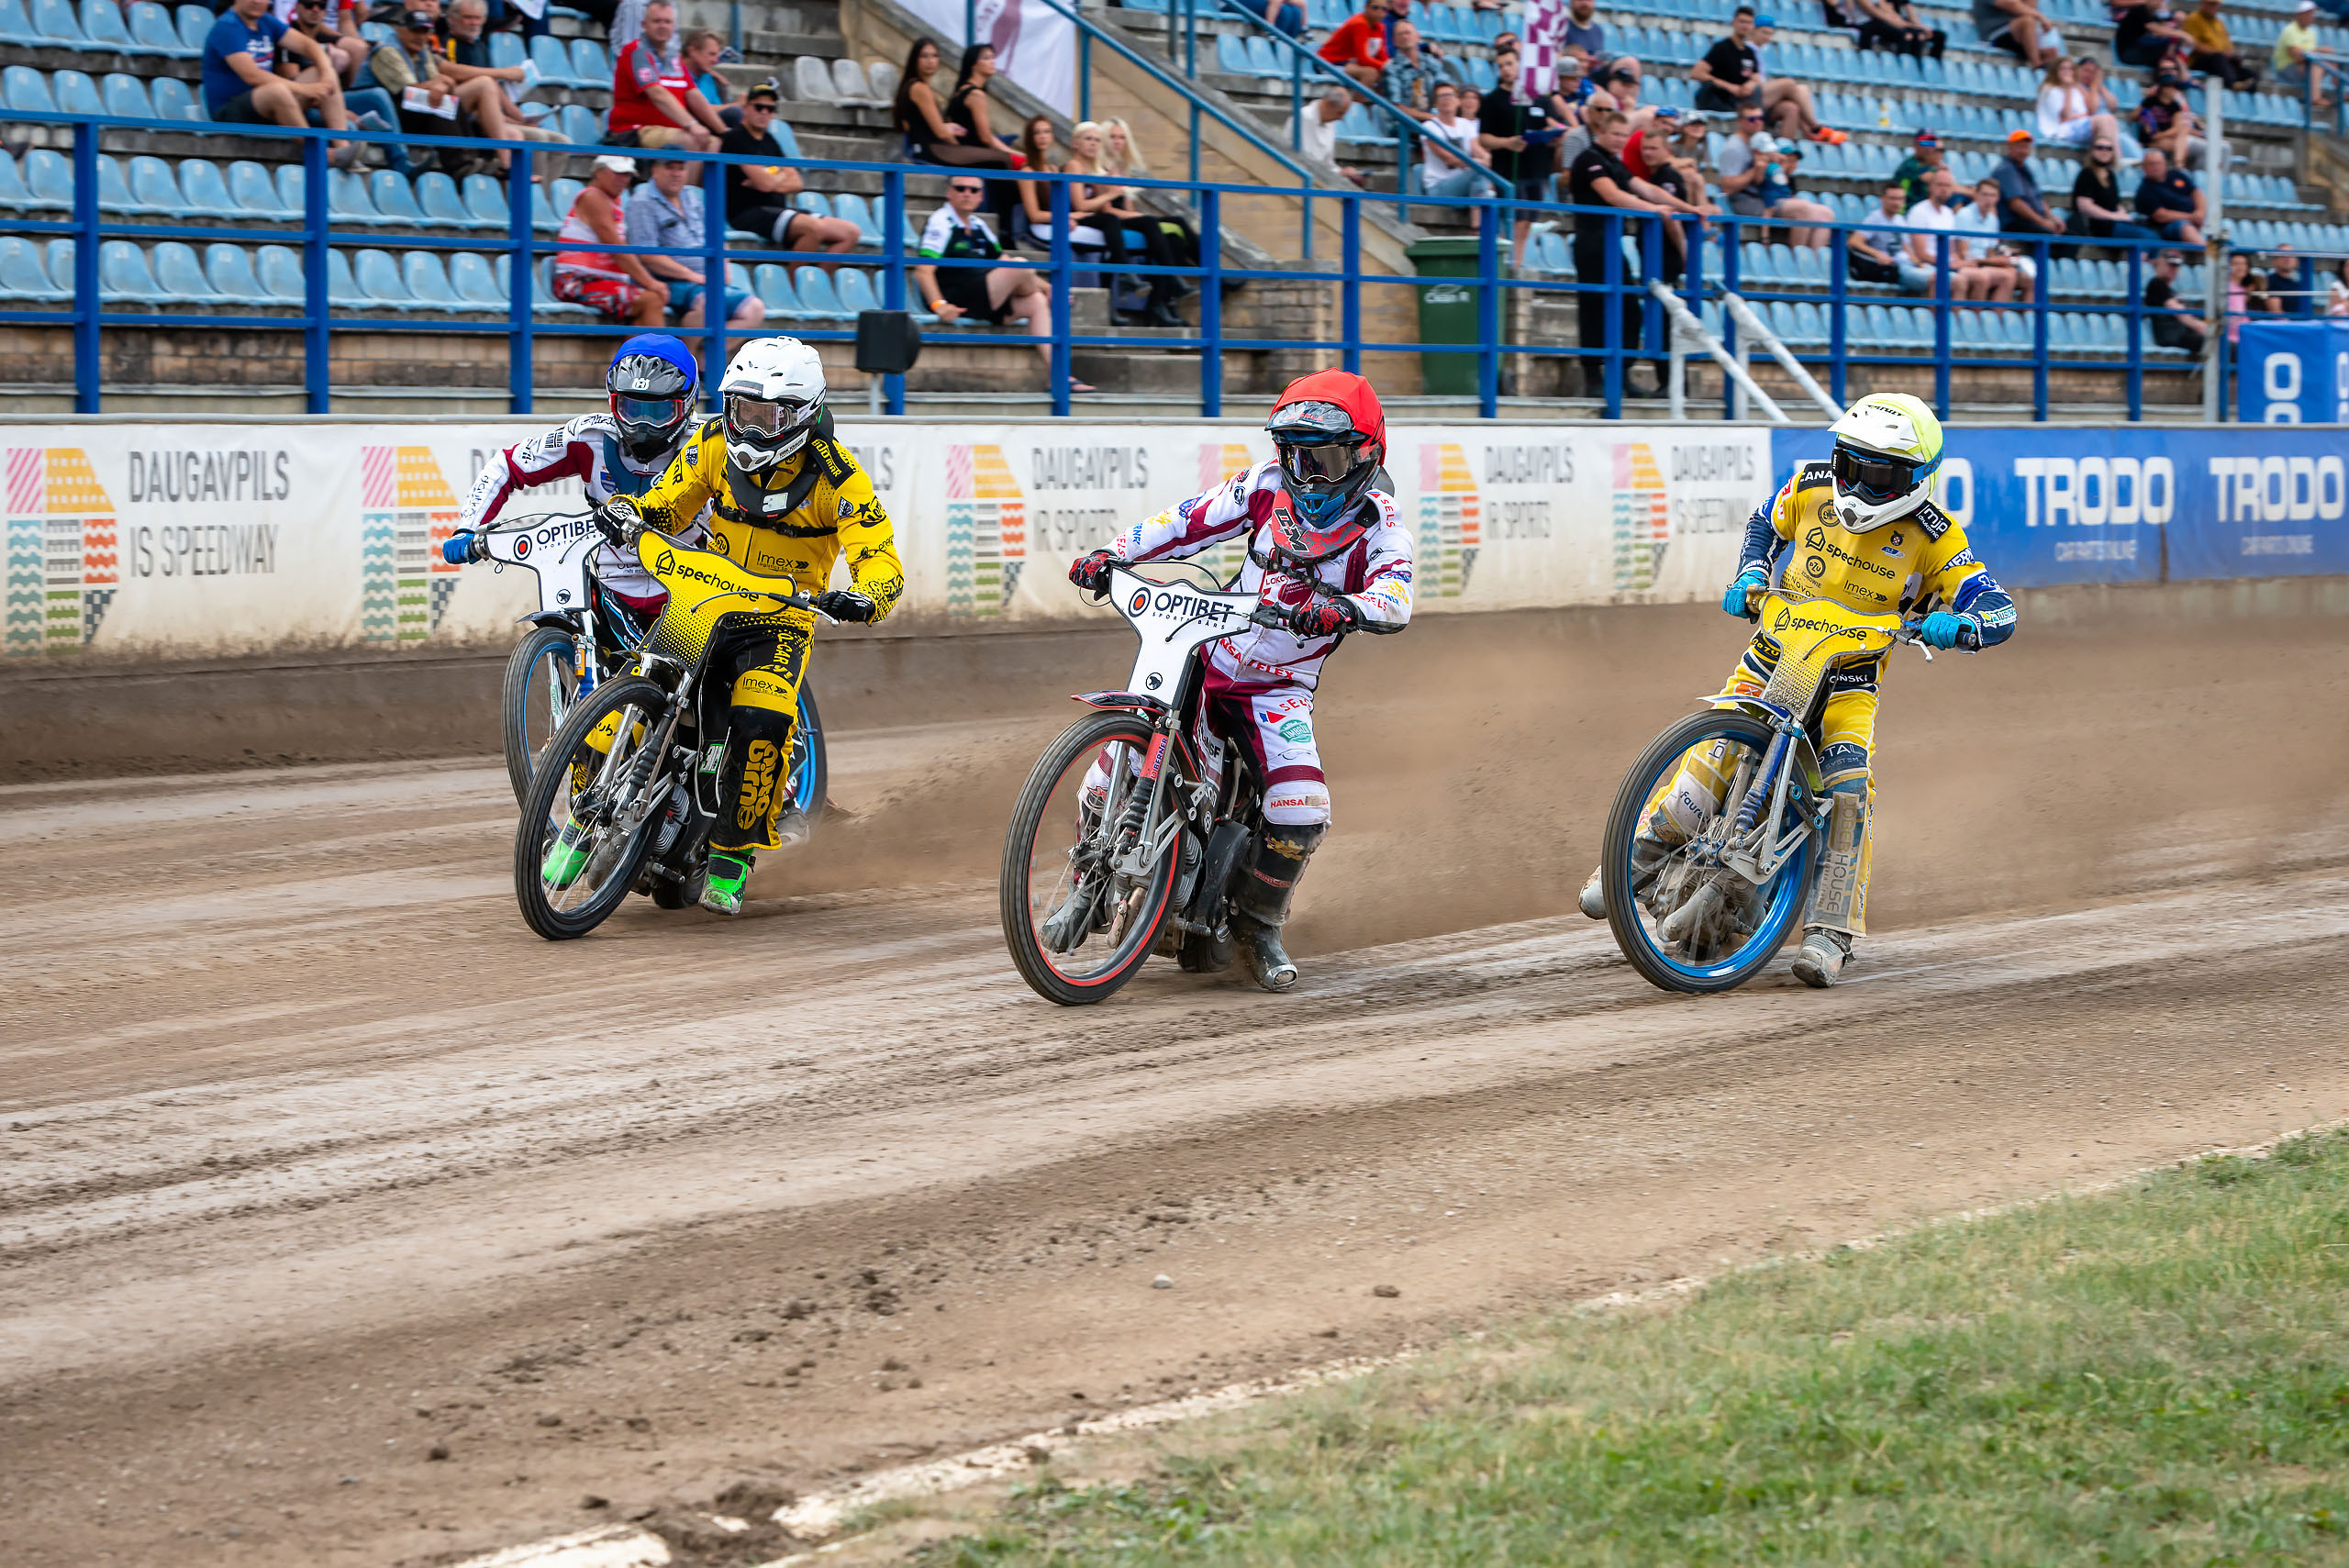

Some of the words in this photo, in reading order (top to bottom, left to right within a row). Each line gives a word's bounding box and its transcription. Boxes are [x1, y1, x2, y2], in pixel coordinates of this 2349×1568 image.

[128, 450, 291, 503] DAUGAVPILS
[1031, 447, 1149, 490] DAUGAVPILS
[1485, 445, 1575, 484] DAUGAVPILS
[1671, 445, 1755, 482] DAUGAVPILS
[2015, 457, 2175, 527] TRODO
[2210, 456, 2345, 523] TRODO
[1380, 498, 1396, 528] SELS
[1923, 507, 1948, 532] mjp
[537, 519, 596, 544] OPTIBE
[130, 526, 154, 578] IS
[161, 523, 280, 576] SPEEDWAY
[758, 550, 795, 569] Imex
[1825, 543, 1896, 580] spechouse
[676, 563, 760, 603] spechouse
[1843, 579, 1874, 598] Imex
[1154, 592, 1234, 623] OPTIBET
[1790, 617, 1868, 641] spechouse
[742, 676, 774, 691] Imex
[1152, 737, 1168, 771] BERNER
